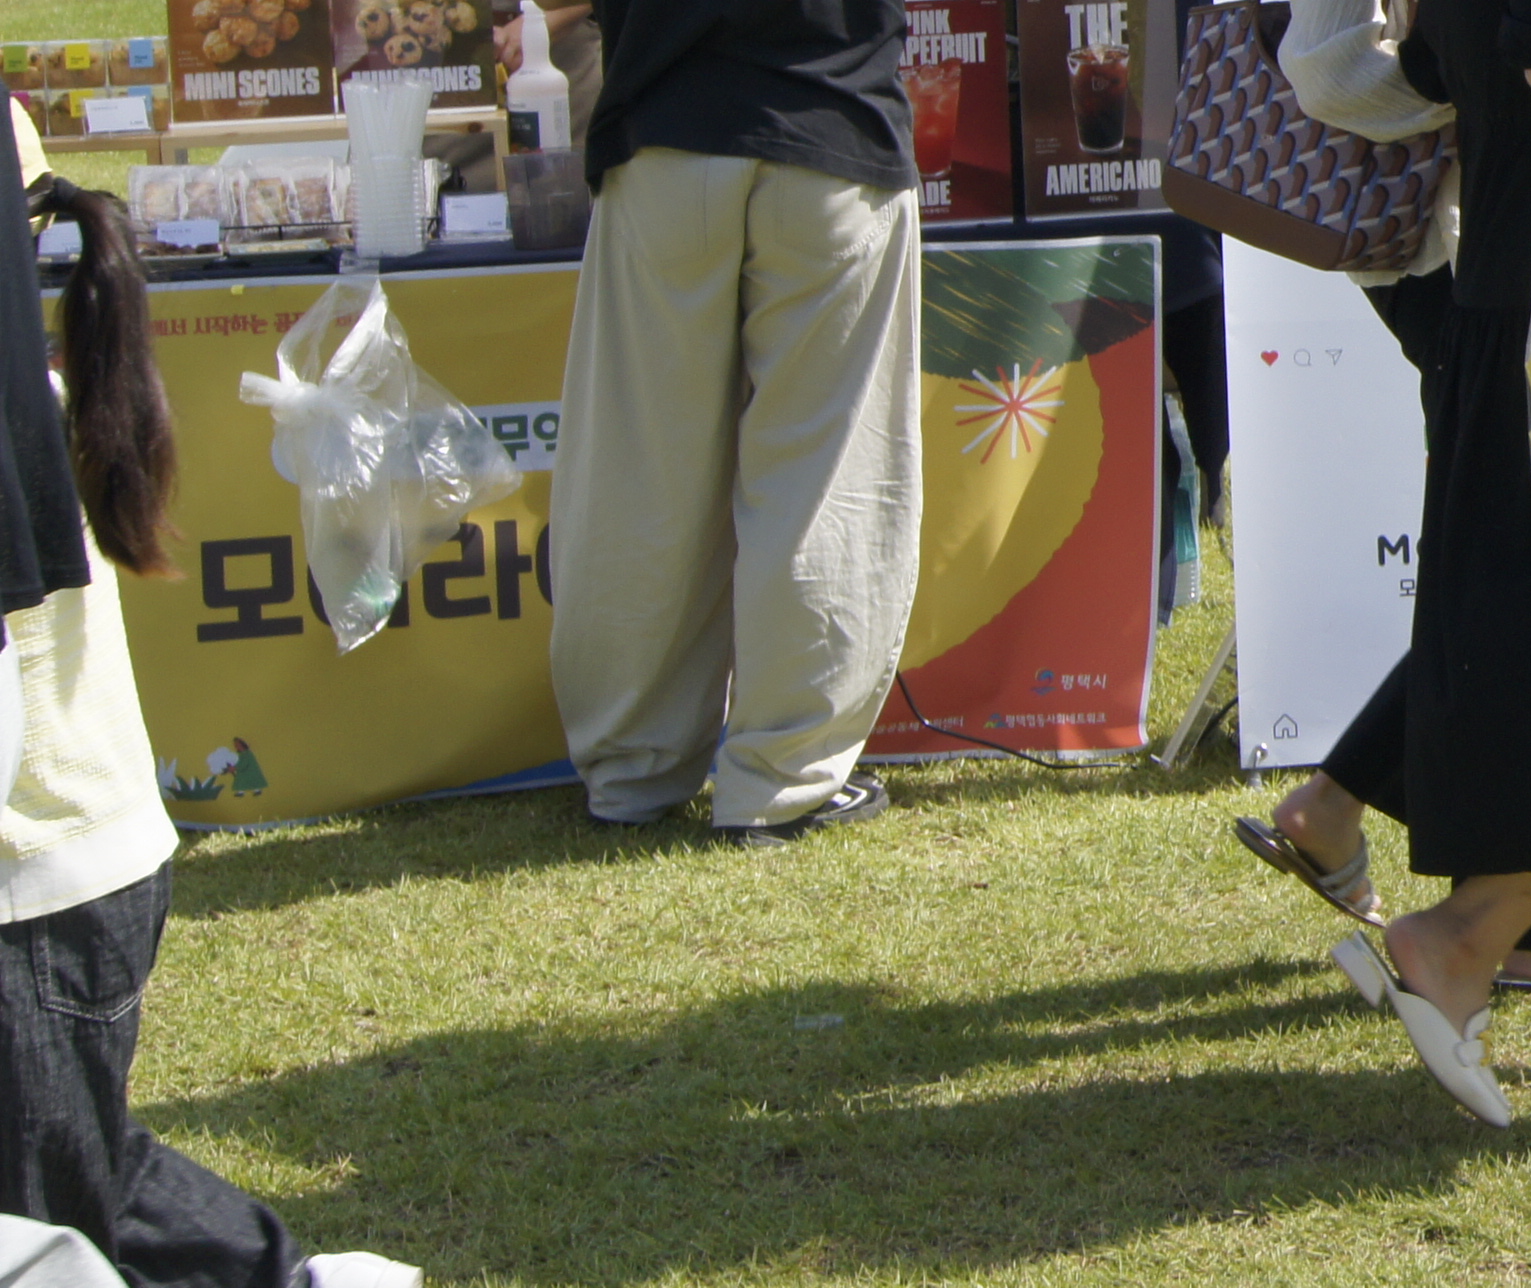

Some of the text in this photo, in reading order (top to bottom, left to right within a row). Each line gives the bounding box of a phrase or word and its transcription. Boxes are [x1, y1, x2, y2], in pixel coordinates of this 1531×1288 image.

[1065, 2, 1129, 50] THE
[184, 67, 321, 101] MINI SCONES
[1046, 159, 1162, 196] AMERICANO
[193, 315, 269, 336] 시작하는
[197, 518, 552, 643] 모라
[1060, 673, 1108, 691] 평택시
